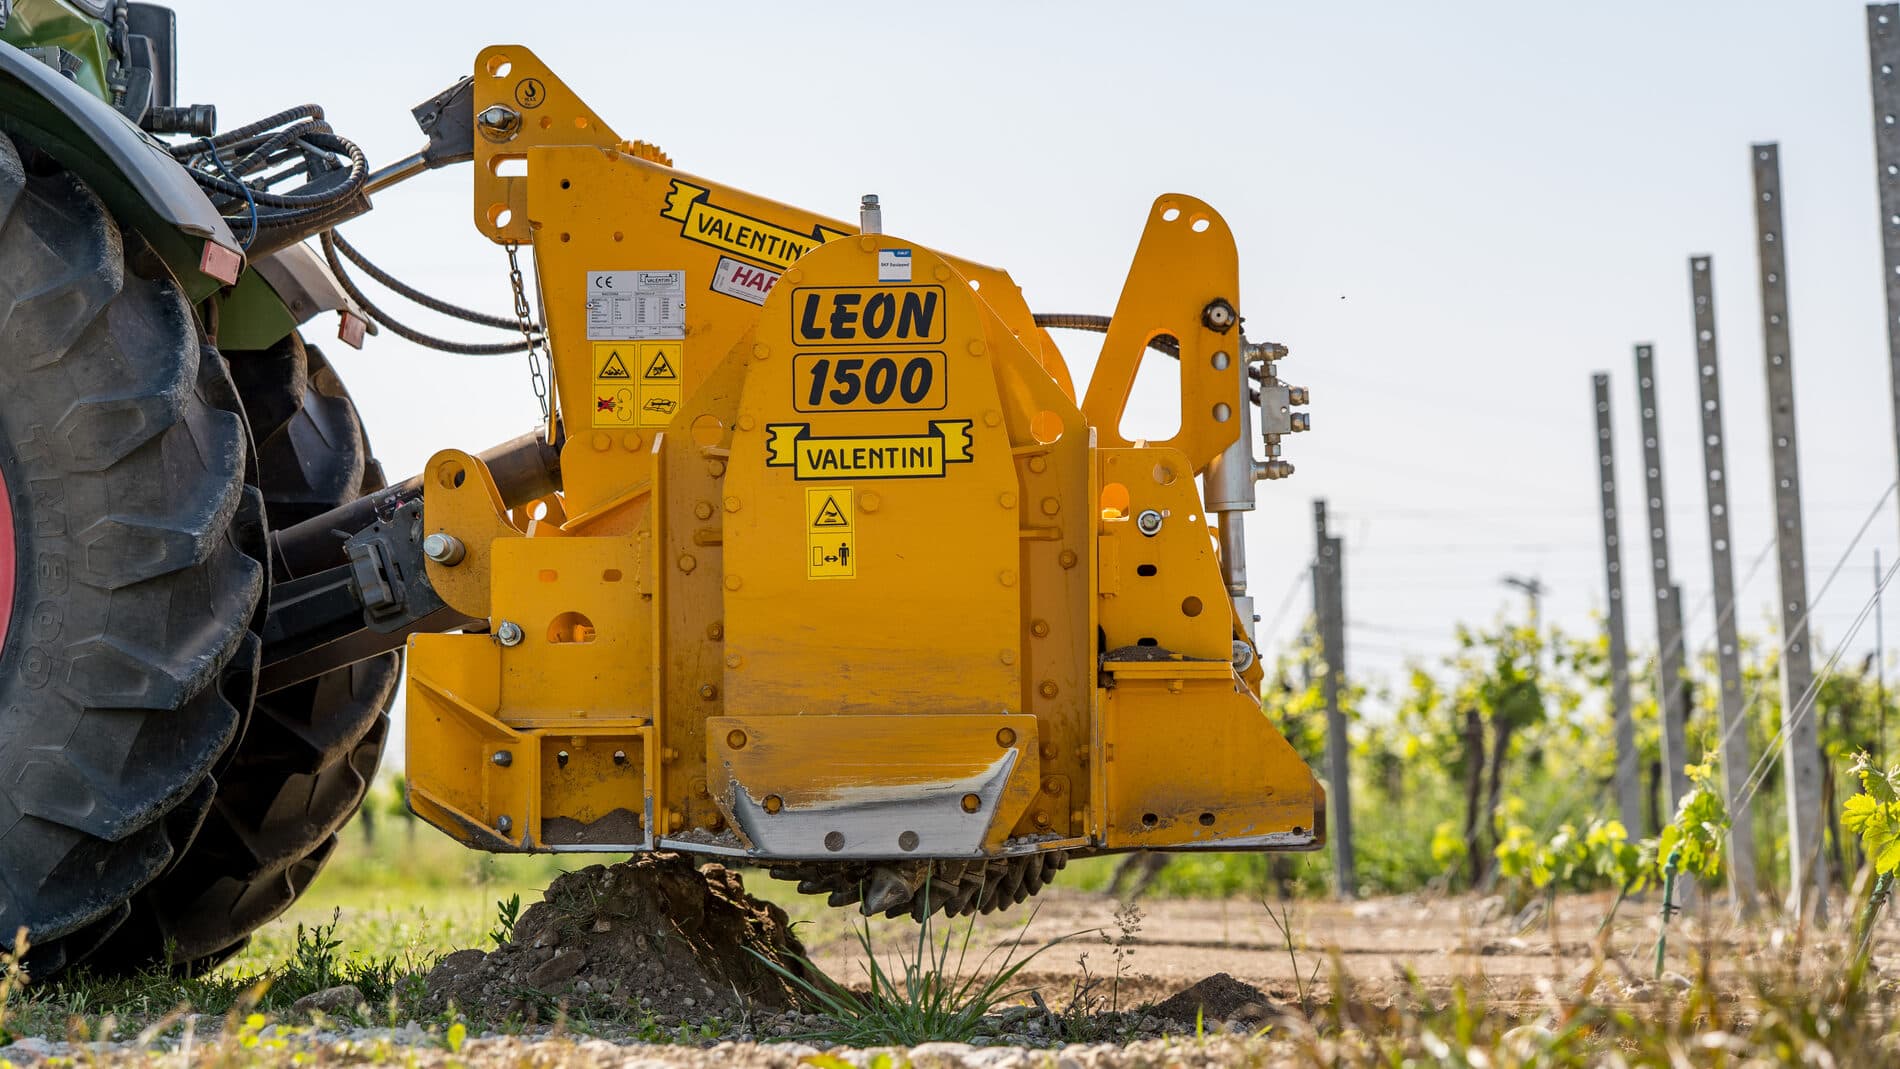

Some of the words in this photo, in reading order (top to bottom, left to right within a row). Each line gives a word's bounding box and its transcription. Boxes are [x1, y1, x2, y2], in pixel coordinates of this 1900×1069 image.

[596, 276, 612, 288] CE
[801, 291, 938, 339] LEON
[808, 357, 933, 405] 1500
[807, 446, 933, 470] VALENTINI
